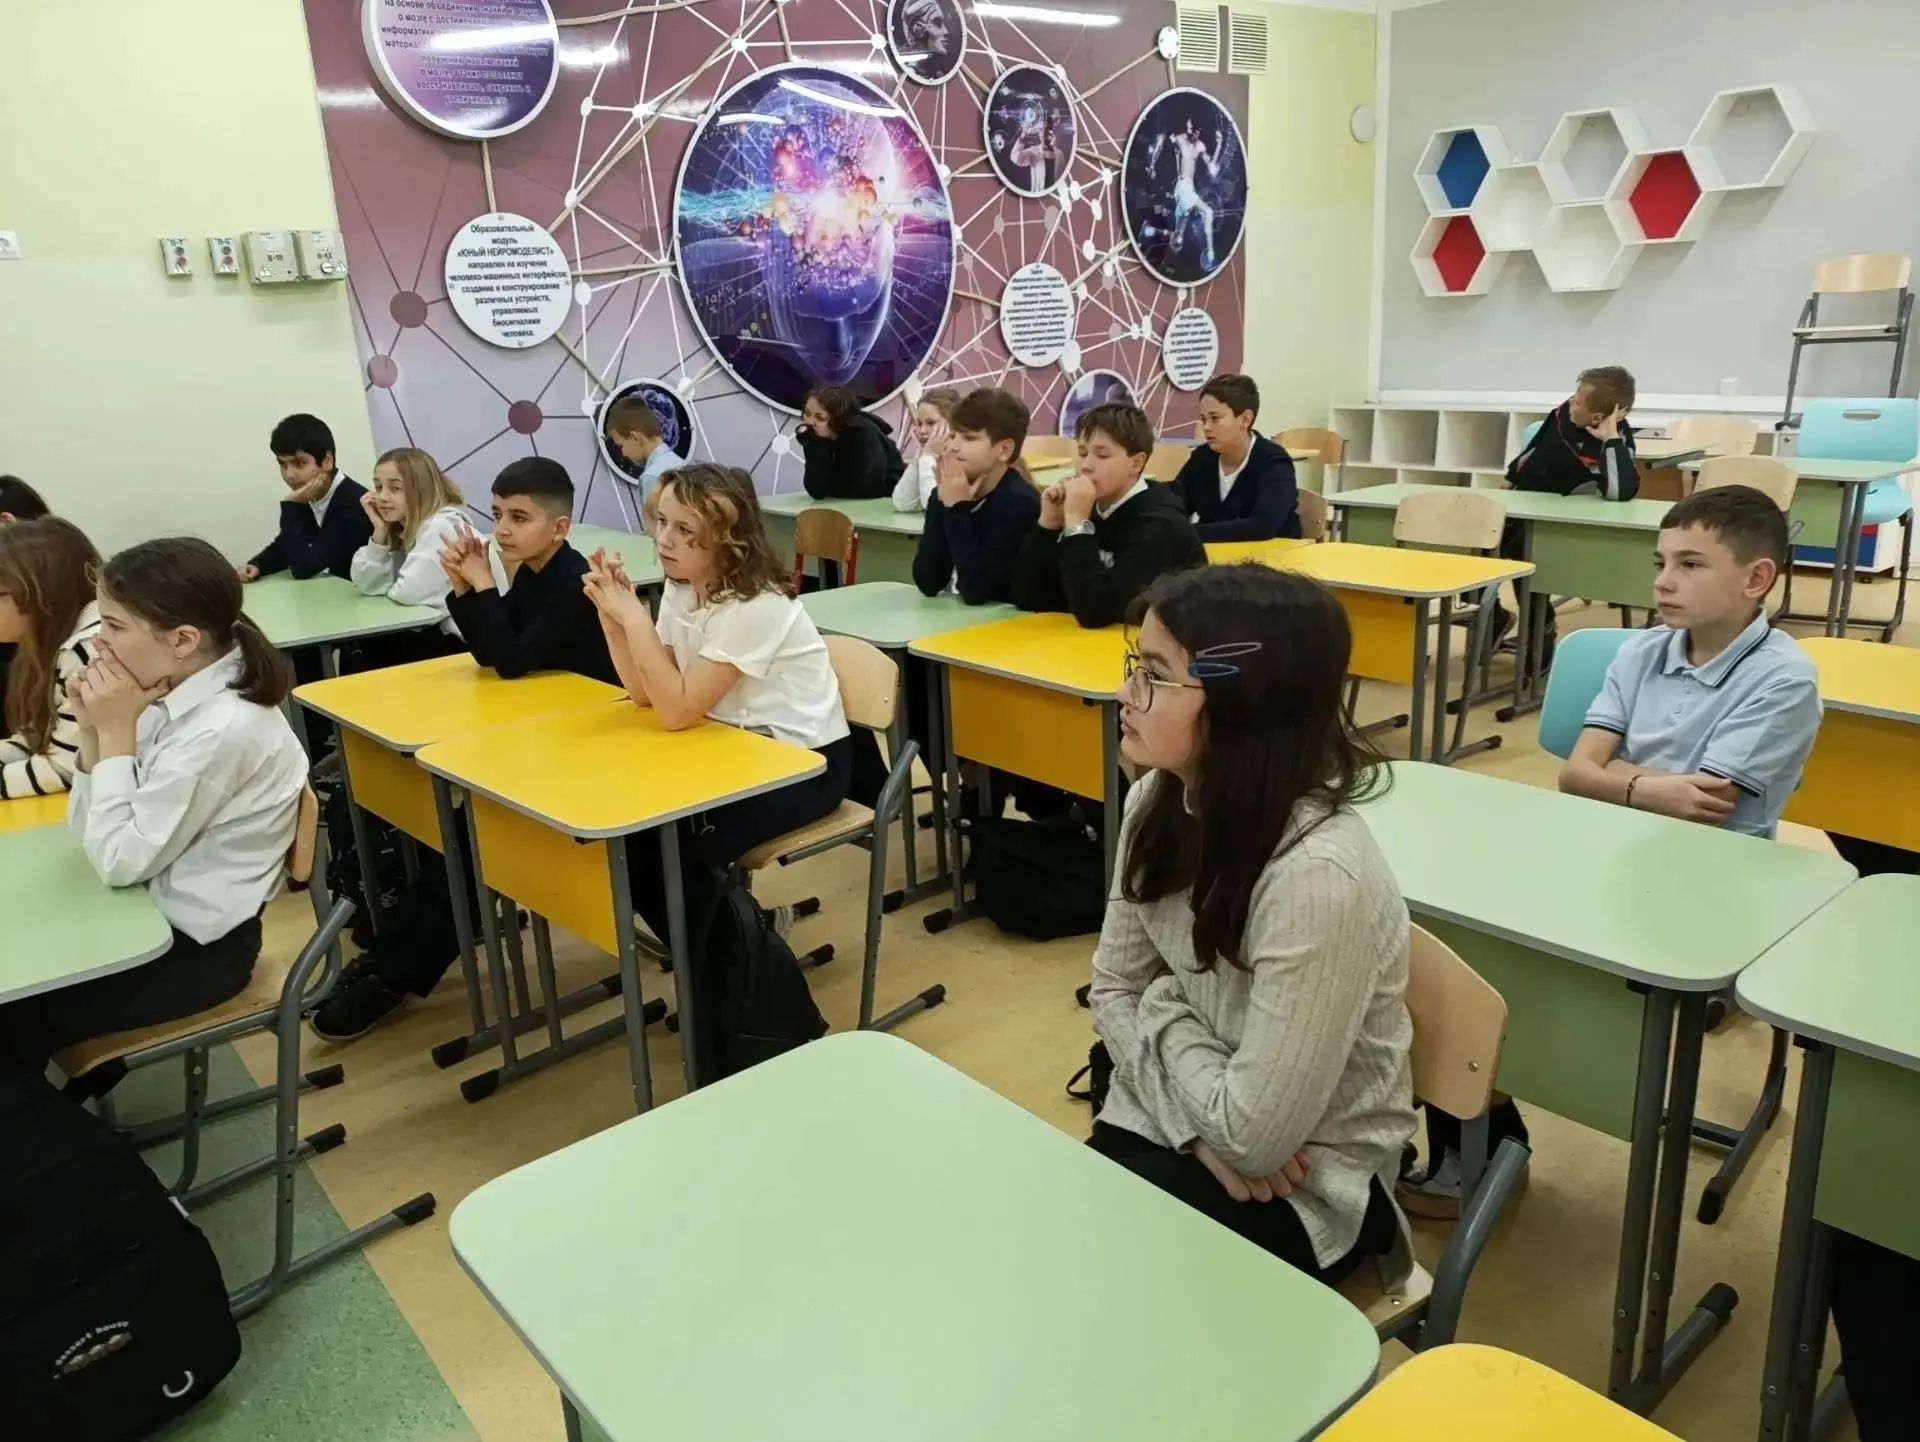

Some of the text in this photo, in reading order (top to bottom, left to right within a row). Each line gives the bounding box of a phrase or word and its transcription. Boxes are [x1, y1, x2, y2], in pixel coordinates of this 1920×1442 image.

[396, 0, 424, 9] основе
[405, 13, 428, 23] мозге
[471, 224, 534, 234] Образовательный
[492, 237, 518, 246] модуль
[457, 246, 554, 257] «ЮНЫЙ НЕЙРОМОДЕЛИСТ»
[468, 261, 505, 270] направлен
[517, 260, 547, 270] изучение
[448, 272, 520, 282] человеко-машинных
[461, 284, 495, 294] создание
[502, 283, 560, 293] конструирование
[475, 296, 513, 306] различных
[491, 306, 538, 317] управляемых
[492, 318, 541, 327] биосигналами
[95, 1321, 130, 1334] house
